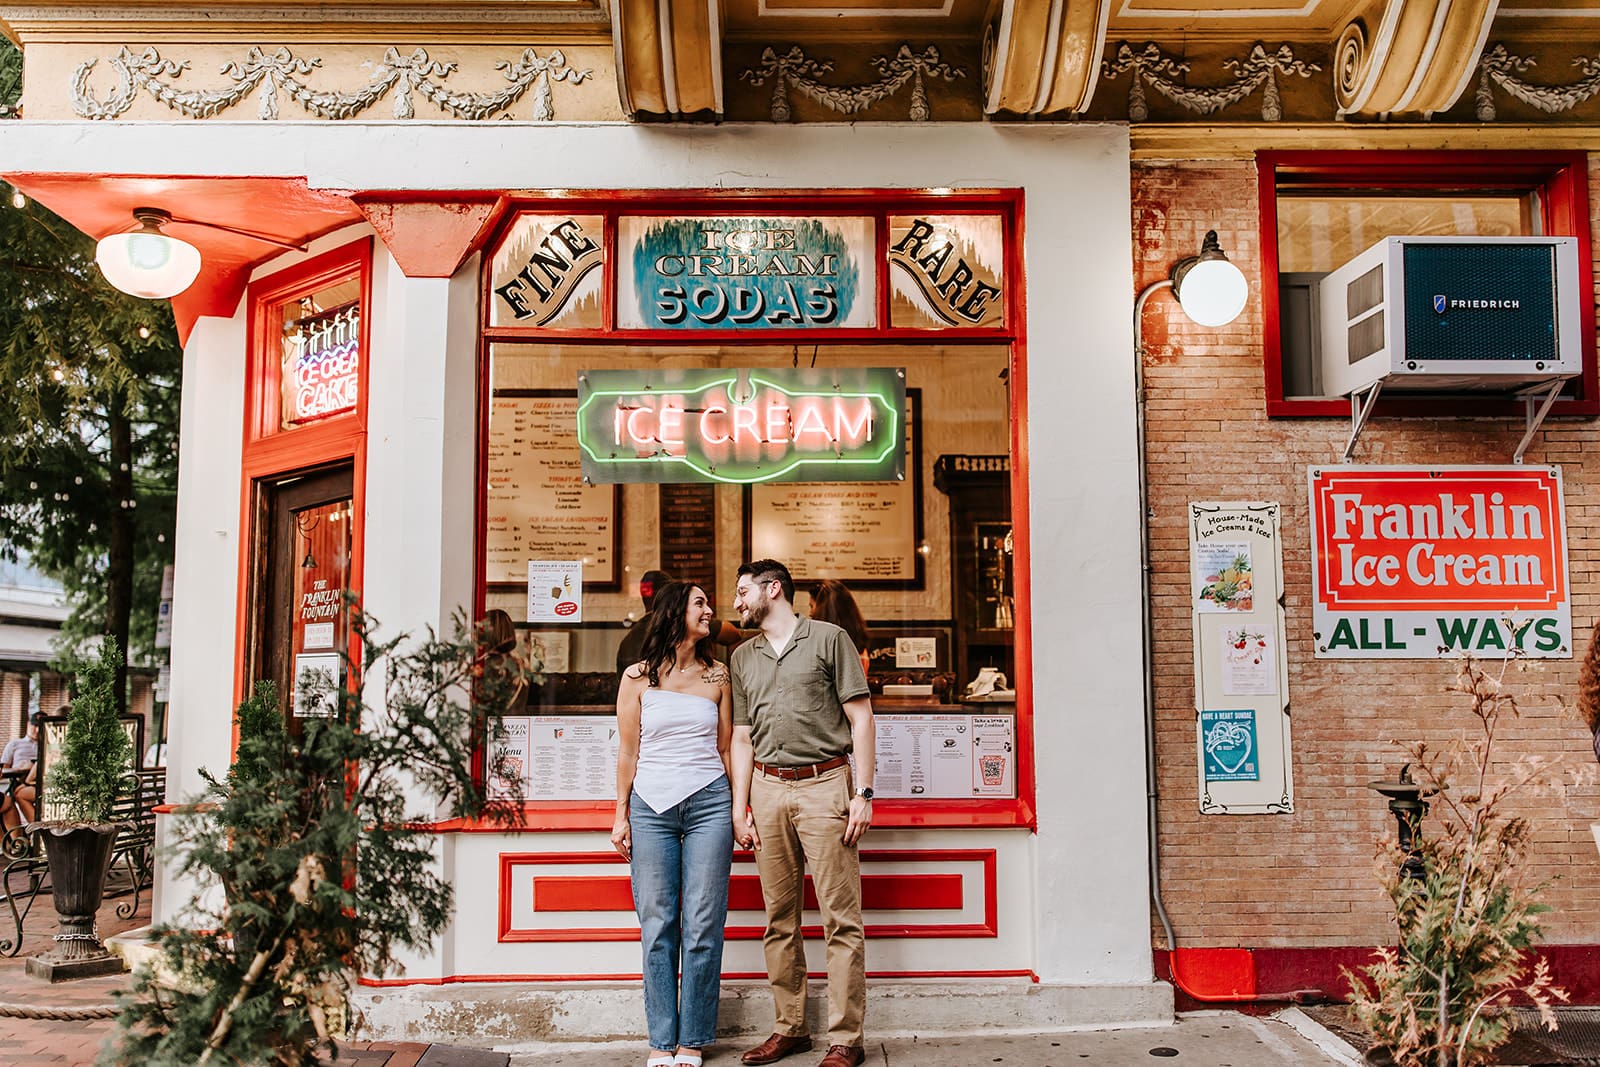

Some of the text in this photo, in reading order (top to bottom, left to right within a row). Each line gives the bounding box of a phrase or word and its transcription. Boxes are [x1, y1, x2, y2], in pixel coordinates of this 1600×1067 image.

[697, 228, 797, 252] ICE
[495, 220, 601, 320] FINE
[655, 255, 838, 278] CREAM
[891, 219, 1003, 324] RARE
[655, 281, 839, 325] SODAS
[1450, 299, 1520, 309] FRIEDRICH
[294, 351, 359, 390] ICE CREA
[296, 375, 358, 416] CAKE
[614, 406, 873, 446] ICE CREAM
[1207, 514, 1265, 526] House-Made
[1329, 492, 1544, 540] Franklin
[1201, 529, 1214, 539] Ice
[1215, 524, 1245, 536] Creams
[1255, 528, 1272, 539] Ices
[1336, 542, 1544, 586] Ice Cream
[301, 589, 341, 608] FRANKLIN
[313, 580, 328, 590] THE
[301, 603, 341, 621] FOUNTAIN
[1326, 619, 1407, 650] ALL
[1435, 618, 1562, 652] WAYS
[498, 747, 522, 756] Menu
